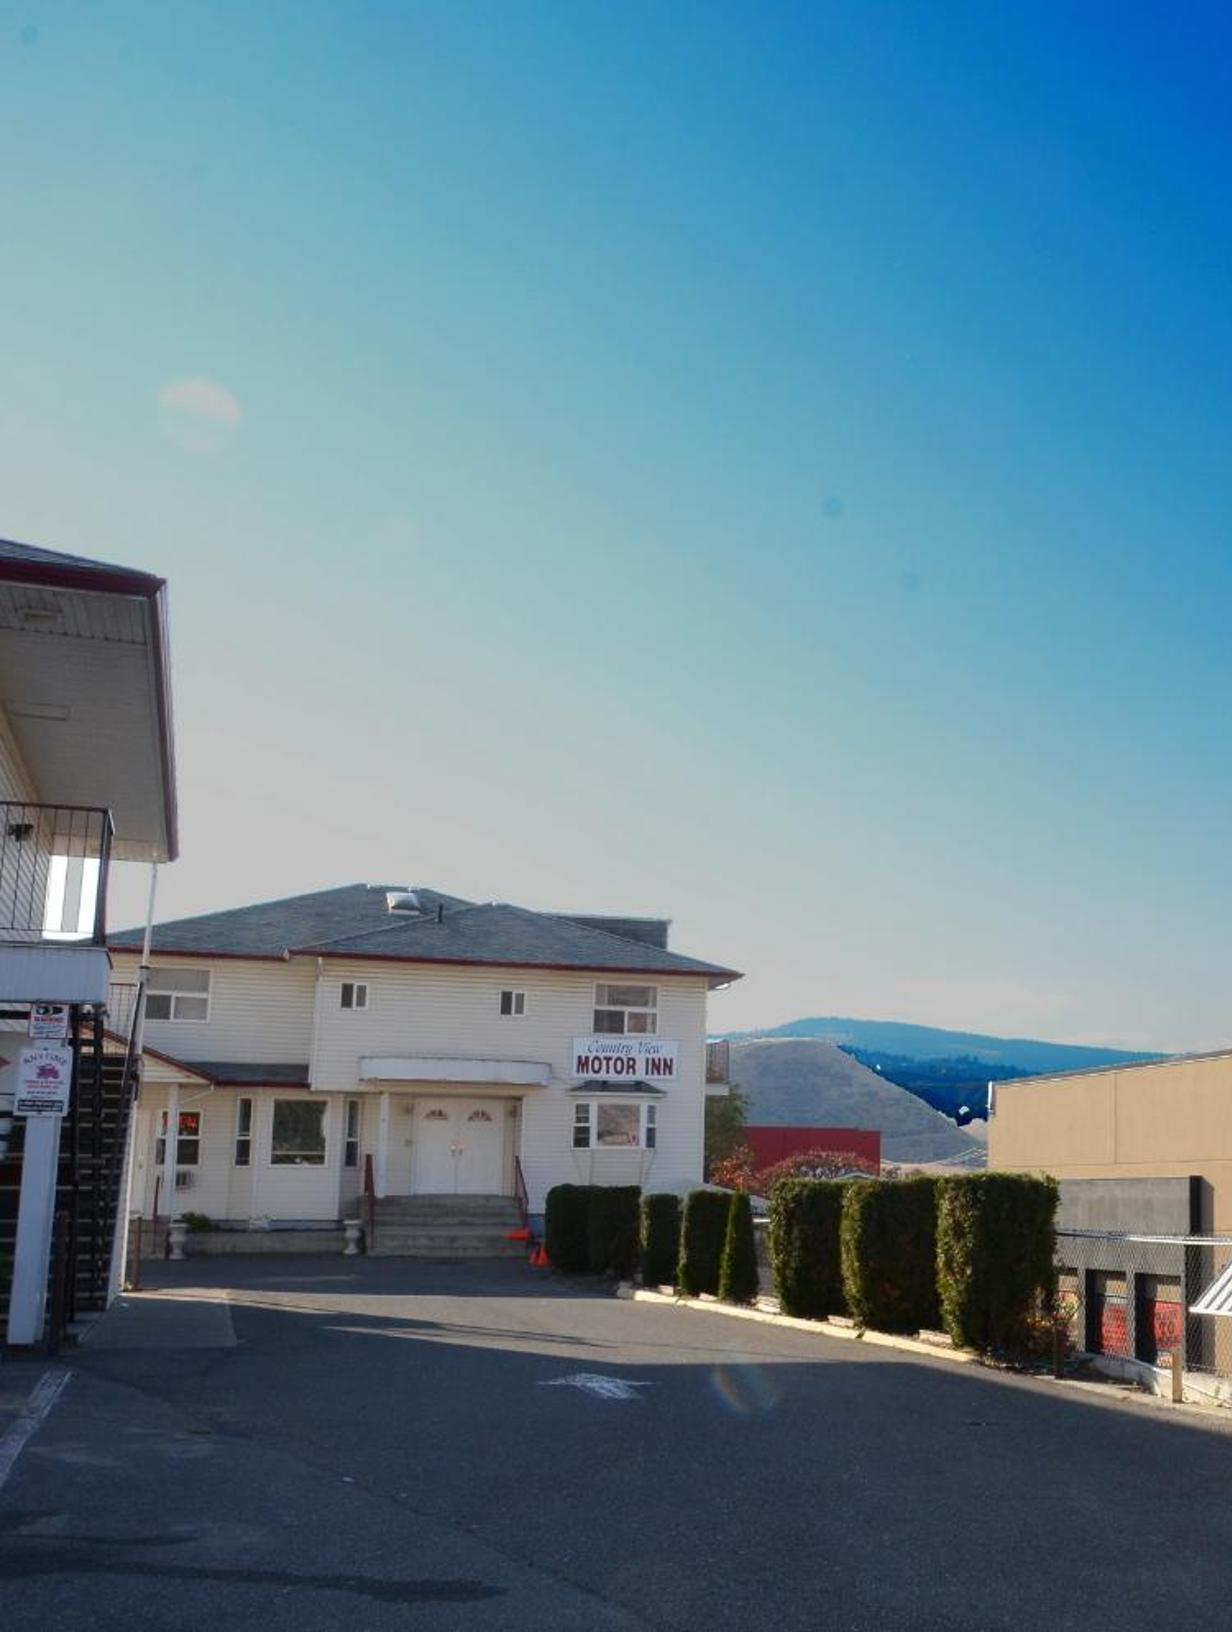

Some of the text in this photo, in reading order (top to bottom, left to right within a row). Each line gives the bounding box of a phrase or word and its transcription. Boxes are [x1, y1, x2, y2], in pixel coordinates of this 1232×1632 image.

[587, 1040, 663, 1056] Country View
[576, 1055, 674, 1076] MOTOR INN
